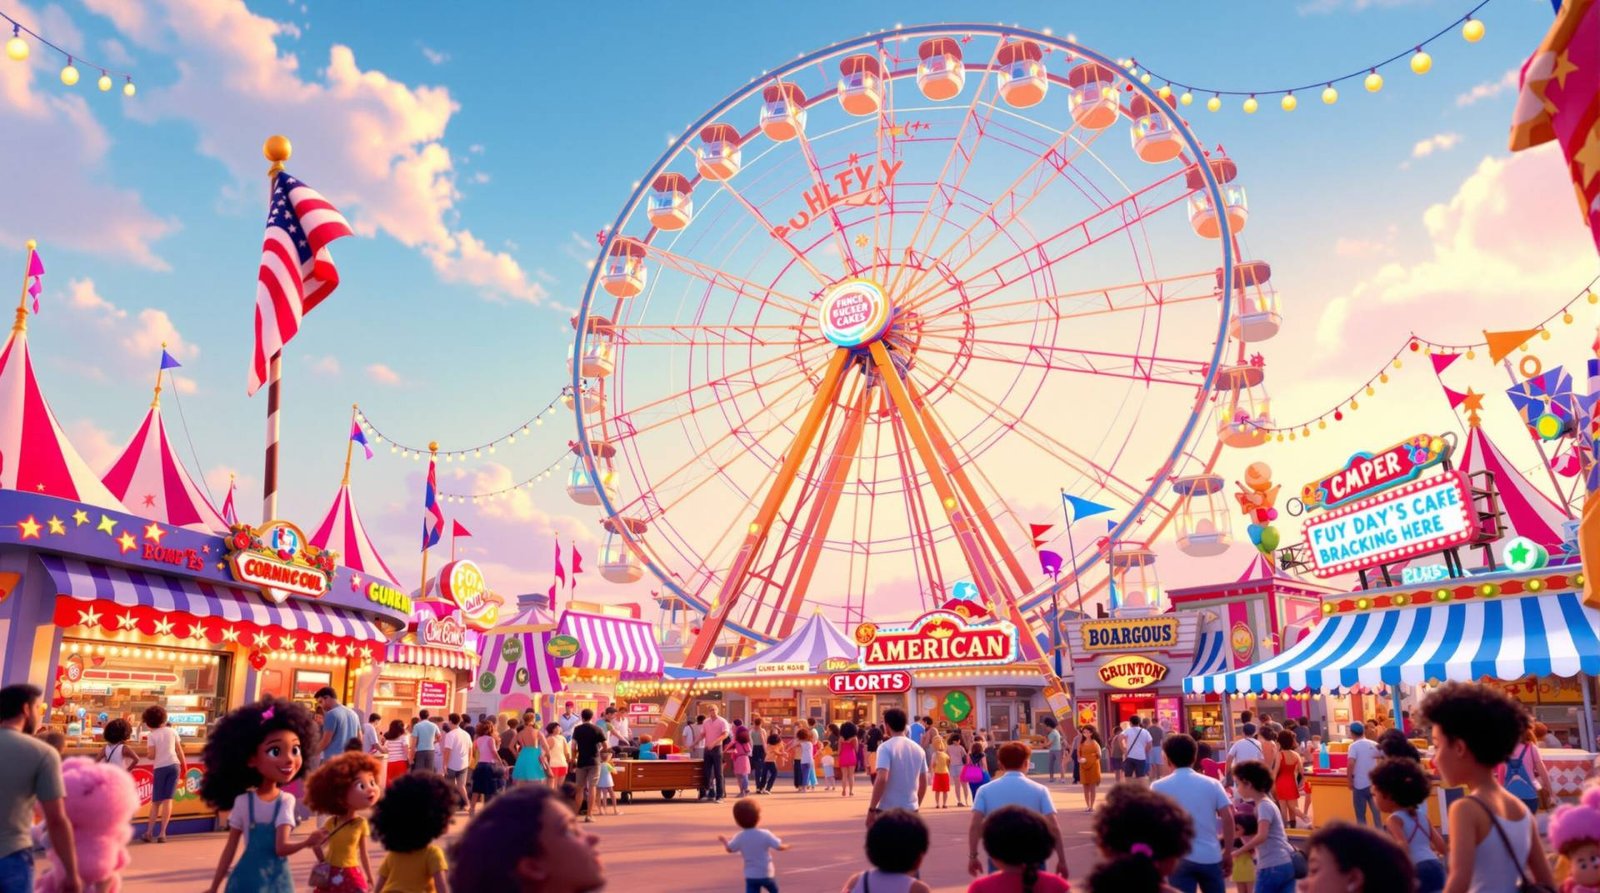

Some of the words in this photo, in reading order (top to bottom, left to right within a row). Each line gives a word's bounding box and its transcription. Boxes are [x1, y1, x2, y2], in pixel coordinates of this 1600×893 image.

[1331, 452, 1401, 498] CMPER
[1314, 523, 1346, 545] FUY
[1353, 503, 1407, 534] DAY'S
[1413, 487, 1458, 515] CAFE
[1320, 529, 1397, 564] BRACKING
[1401, 515, 1444, 541] HERE
[868, 635, 1003, 662] AMERICAN
[1089, 624, 1171, 646] BOARGOUS
[834, 673, 903, 690] FLORTS
[1100, 662, 1165, 682] CRUNTON
